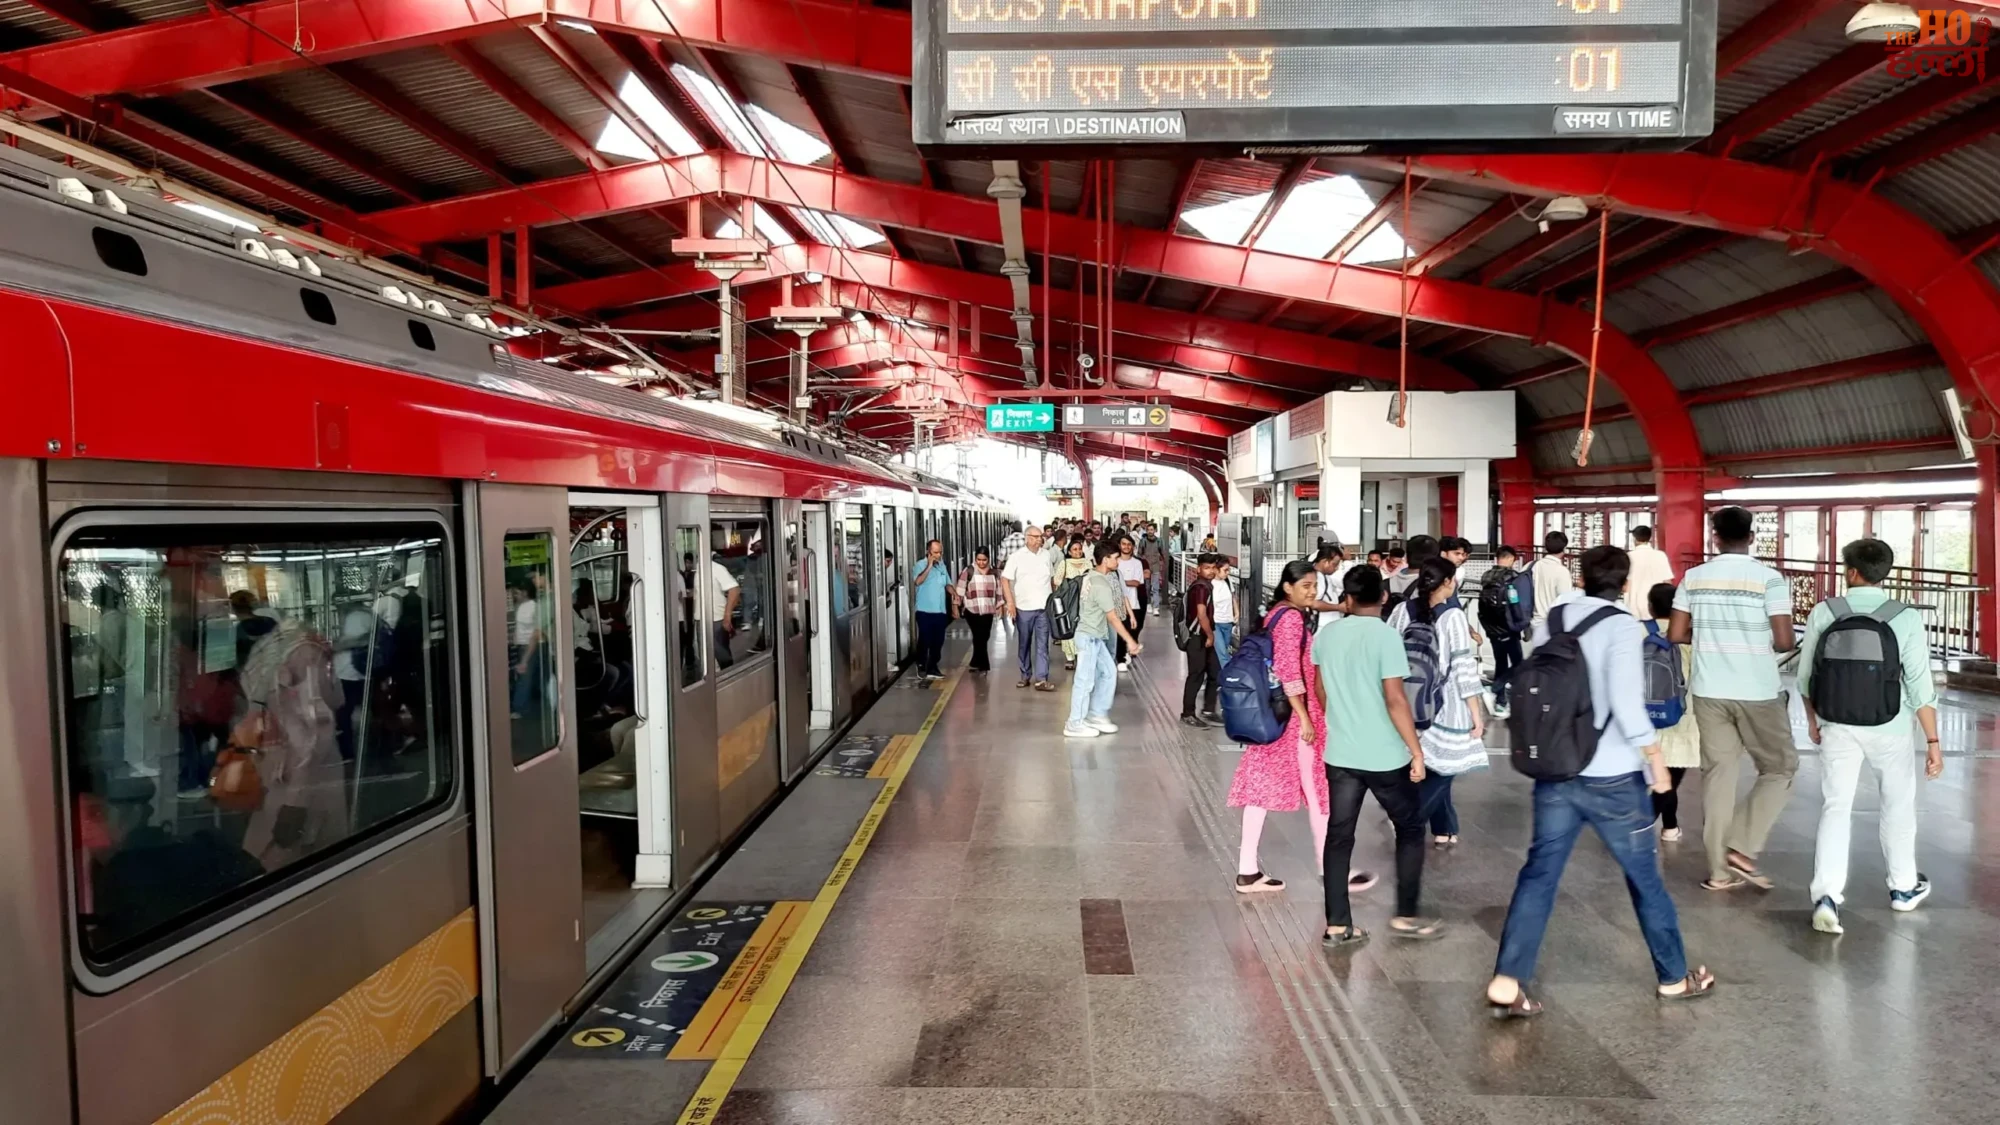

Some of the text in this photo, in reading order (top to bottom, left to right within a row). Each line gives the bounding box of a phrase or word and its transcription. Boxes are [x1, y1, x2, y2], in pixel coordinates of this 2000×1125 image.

[955, 54, 997, 102] सी
[1011, 54, 1054, 102] सी
[1067, 65, 1123, 105] एस
[1008, 118, 1049, 135] स्थान
[1064, 117, 1182, 135] DESTINATION
[1562, 110, 1611, 129] समय
[1627, 110, 1671, 128] TIME
[1102, 407, 1125, 416] निकास
[1006, 419, 1033, 427] EXIT
[639, 979, 688, 1008] निकास
